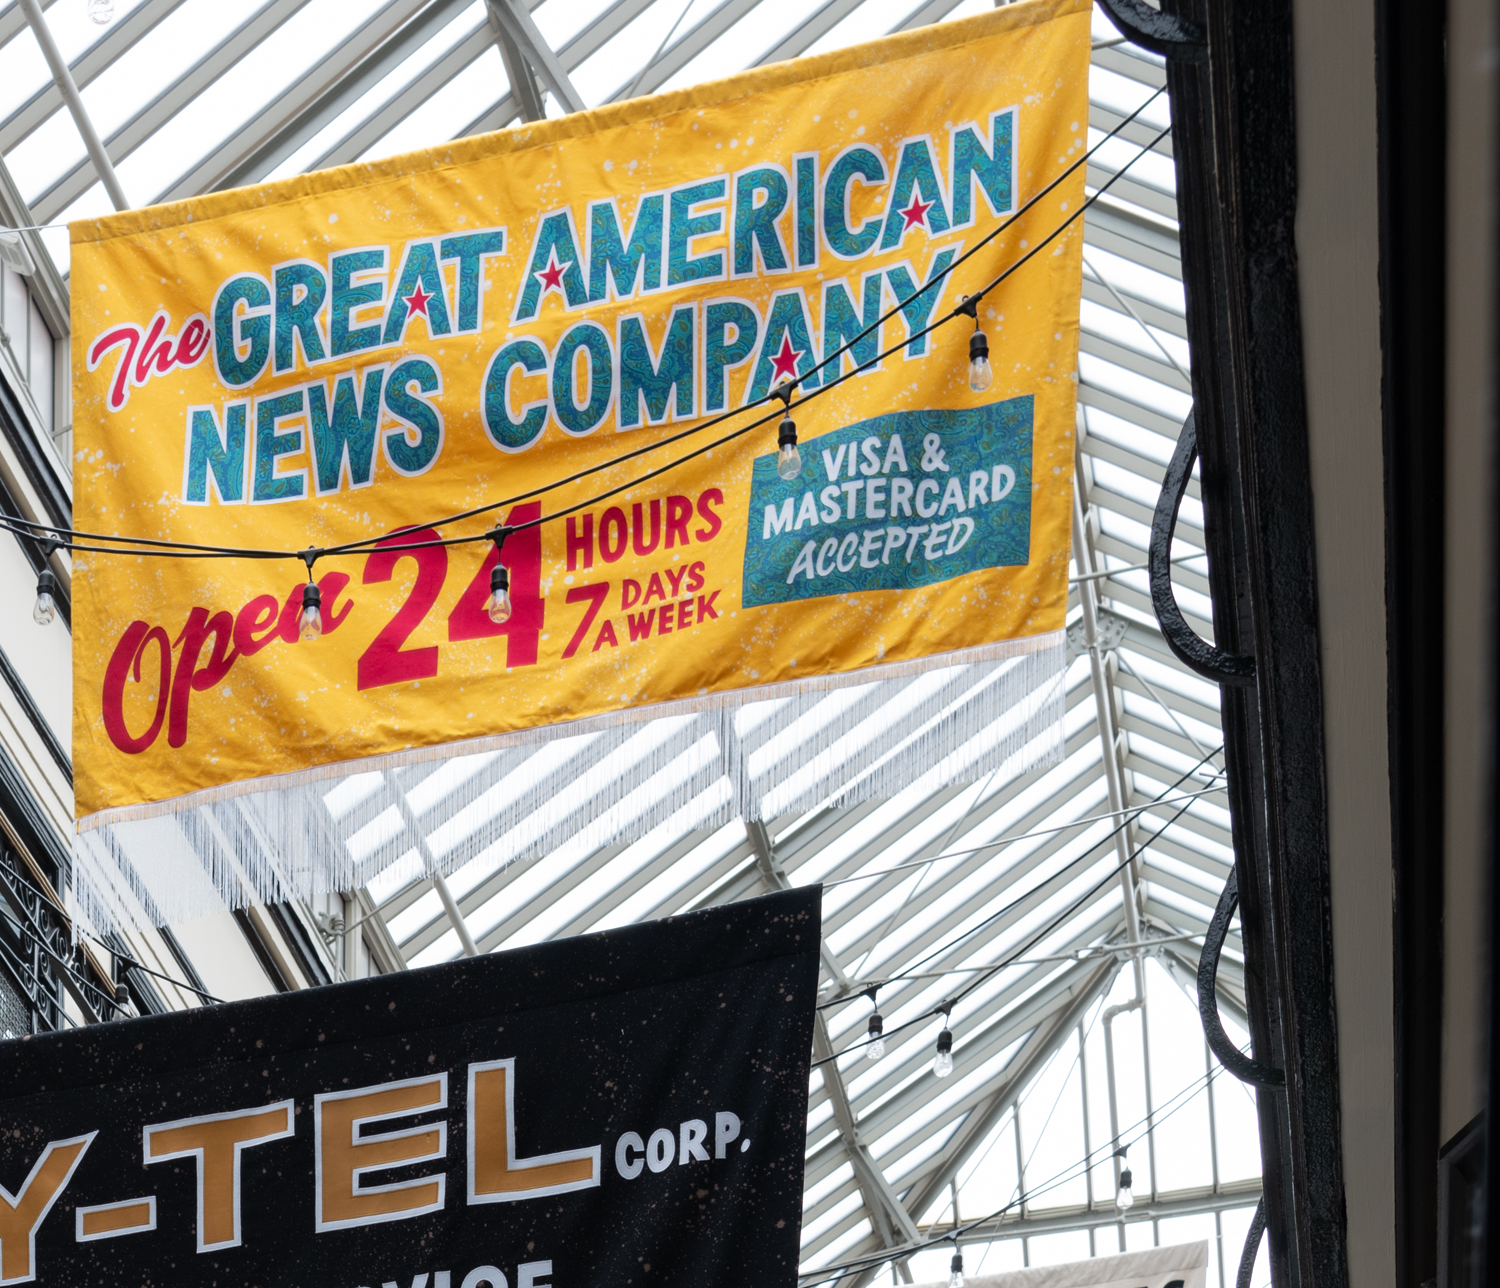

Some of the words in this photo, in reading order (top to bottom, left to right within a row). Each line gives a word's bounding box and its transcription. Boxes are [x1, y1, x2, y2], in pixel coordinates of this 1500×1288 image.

[88, 307, 211, 413] The
[211, 227, 506, 390] GREAT
[509, 104, 1020, 327] AMERICAN
[182, 354, 443, 506] NEWS
[480, 241, 961, 453] COMPANY
[822, 434, 909, 481] VISA
[920, 433, 950, 472] &
[762, 465, 1016, 539] MASTERCARD
[786, 517, 975, 584] ACCEPTED
[102, 571, 354, 754] Open
[357, 500, 545, 692] 24
[566, 488, 724, 573] HOURS
[561, 581, 610, 659] 7
[621, 561, 706, 611] DAYS
[591, 623, 619, 652] A
[626, 590, 721, 641] WEEK
[615, 1110, 752, 1181] CORP.
